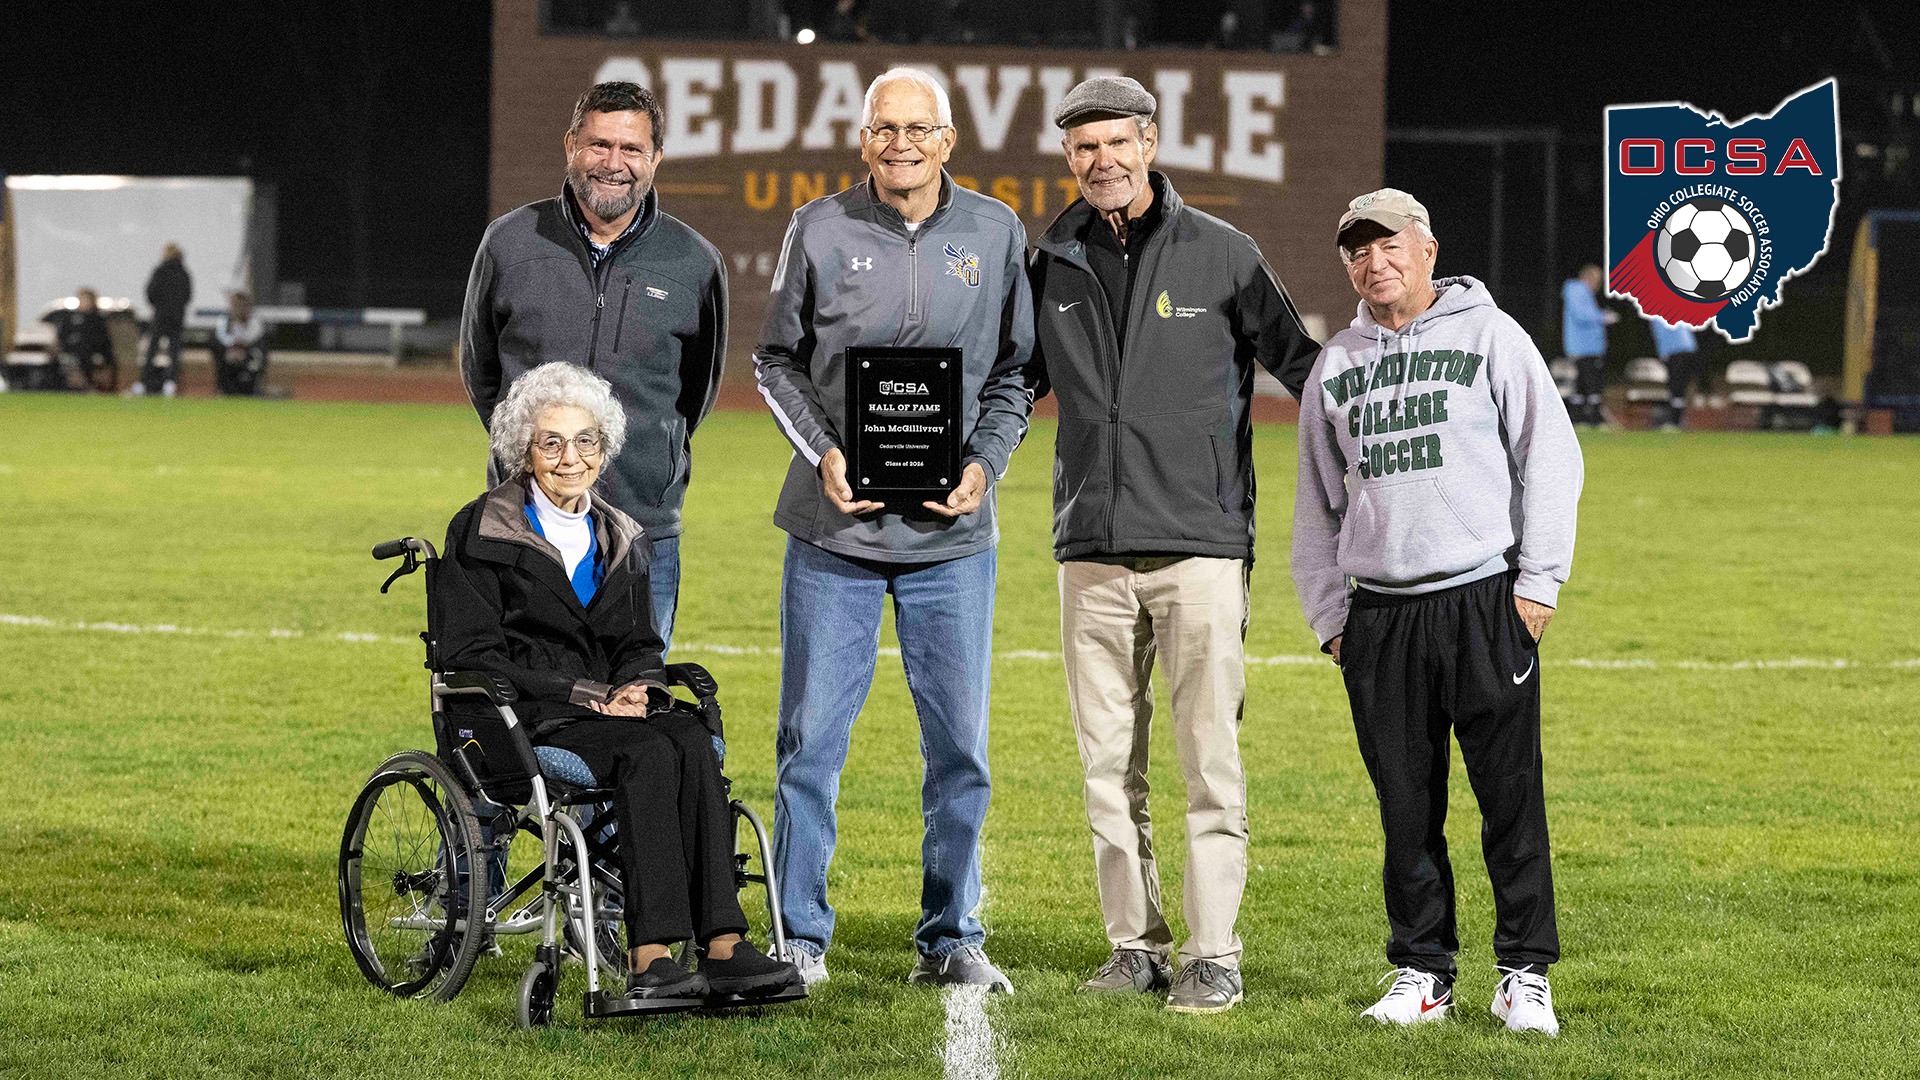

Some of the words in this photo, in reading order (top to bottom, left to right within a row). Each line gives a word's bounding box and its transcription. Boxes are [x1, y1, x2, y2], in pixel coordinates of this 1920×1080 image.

[594, 56, 1286, 182] EDAVILE
[868, 403, 896, 411] HALL
[897, 403, 911, 411] OF
[912, 404, 941, 412] FAME
[1348, 389, 1448, 438] COLLEGE
[864, 424, 886, 433] John
[887, 424, 945, 434] McGillivray
